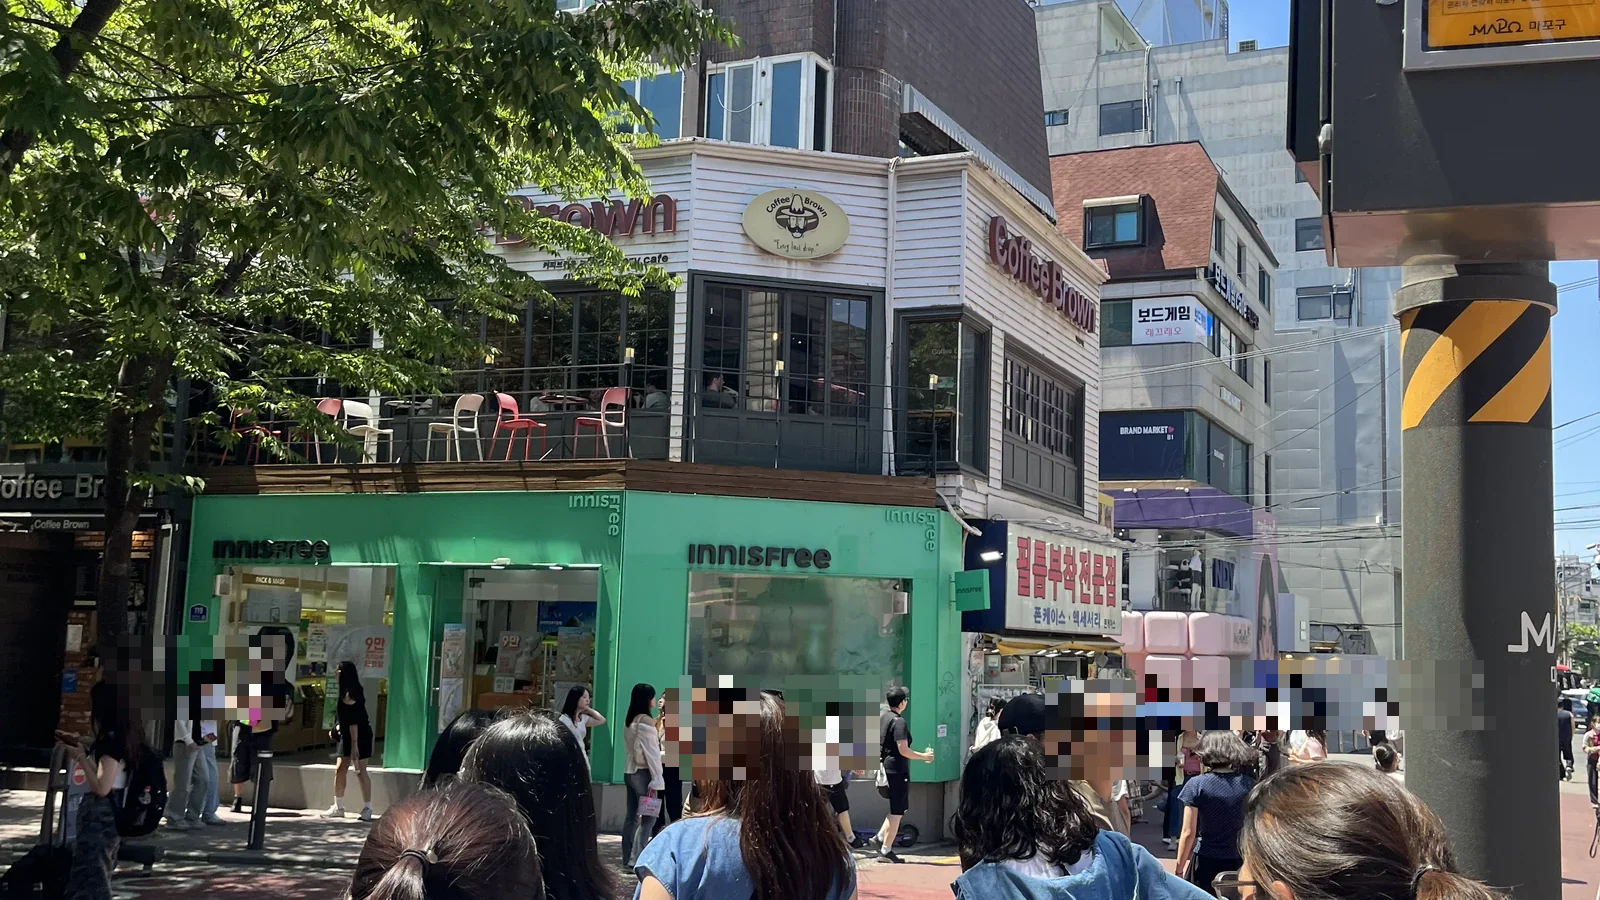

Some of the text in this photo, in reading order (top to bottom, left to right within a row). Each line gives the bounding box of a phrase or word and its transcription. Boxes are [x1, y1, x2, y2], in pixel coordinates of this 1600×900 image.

[1529, 19, 1566, 32] 마포구
[766, 196, 828, 218] Coffee Brown
[643, 253, 669, 264] cafe
[989, 215, 1096, 333] Coffee Brown
[1138, 305, 1190, 323] 보드게임
[1120, 425, 1168, 435] BRAND MARKET
[0, 472, 62, 499] offee
[34, 519, 89, 529] Coffee Brown
[1016, 536, 1117, 608] 필름부착전문점
[255, 576, 267, 584] PACK
[1034, 606, 1066, 626] 폰케이스
[1072, 610, 1101, 628] 액세서리
[365, 637, 386, 651] 9만
[502, 635, 520, 647] 9만
